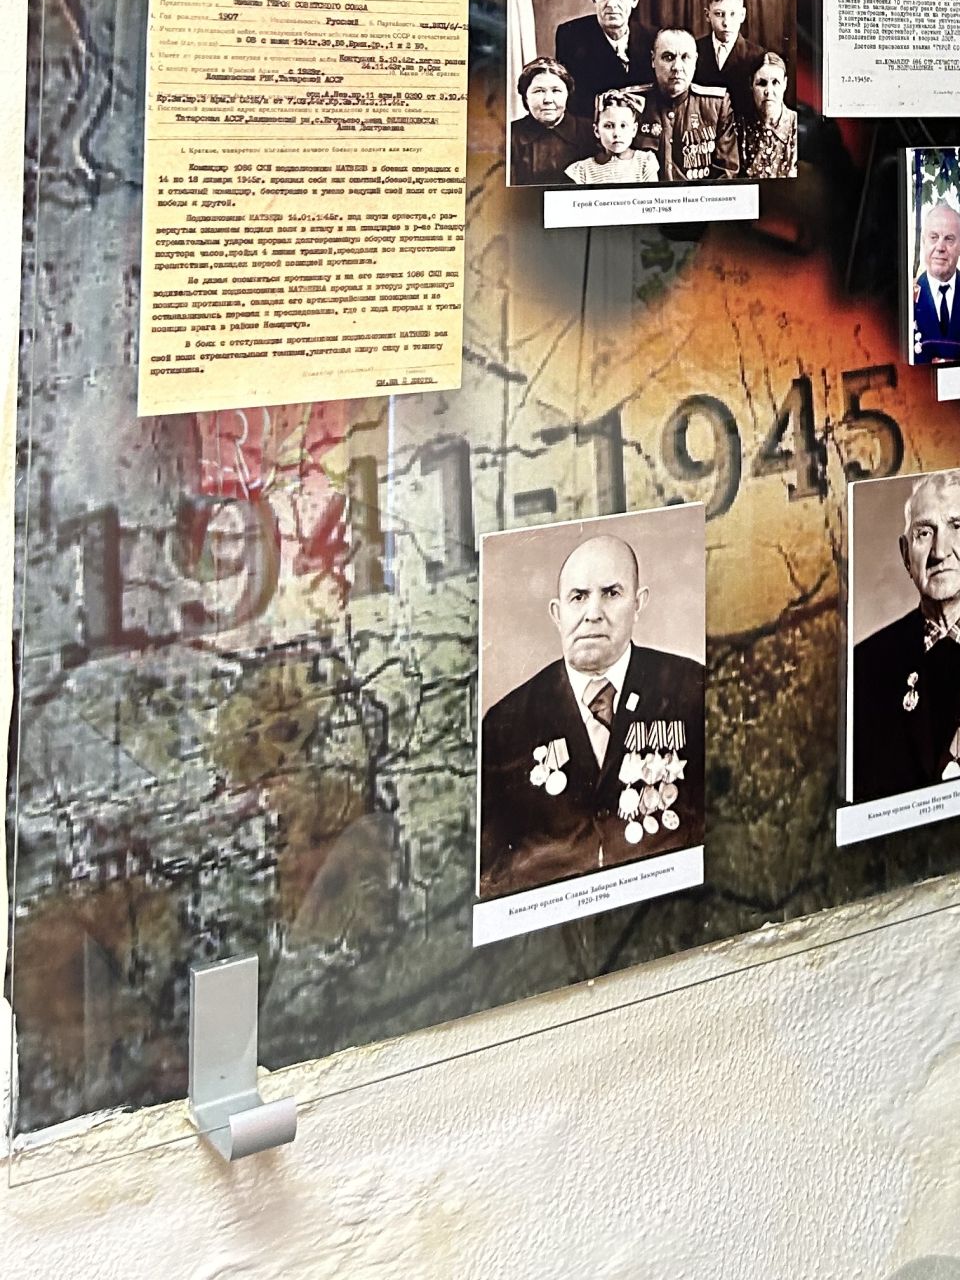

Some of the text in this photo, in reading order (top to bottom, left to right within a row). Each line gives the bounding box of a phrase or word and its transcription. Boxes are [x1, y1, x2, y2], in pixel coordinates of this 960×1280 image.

[325, 17, 358, 25] Русский
[572, 200, 592, 208] Герой
[508, 903, 538, 915] Кавалер
[539, 896, 563, 907] ордена
[564, 889, 588, 900] Славы
